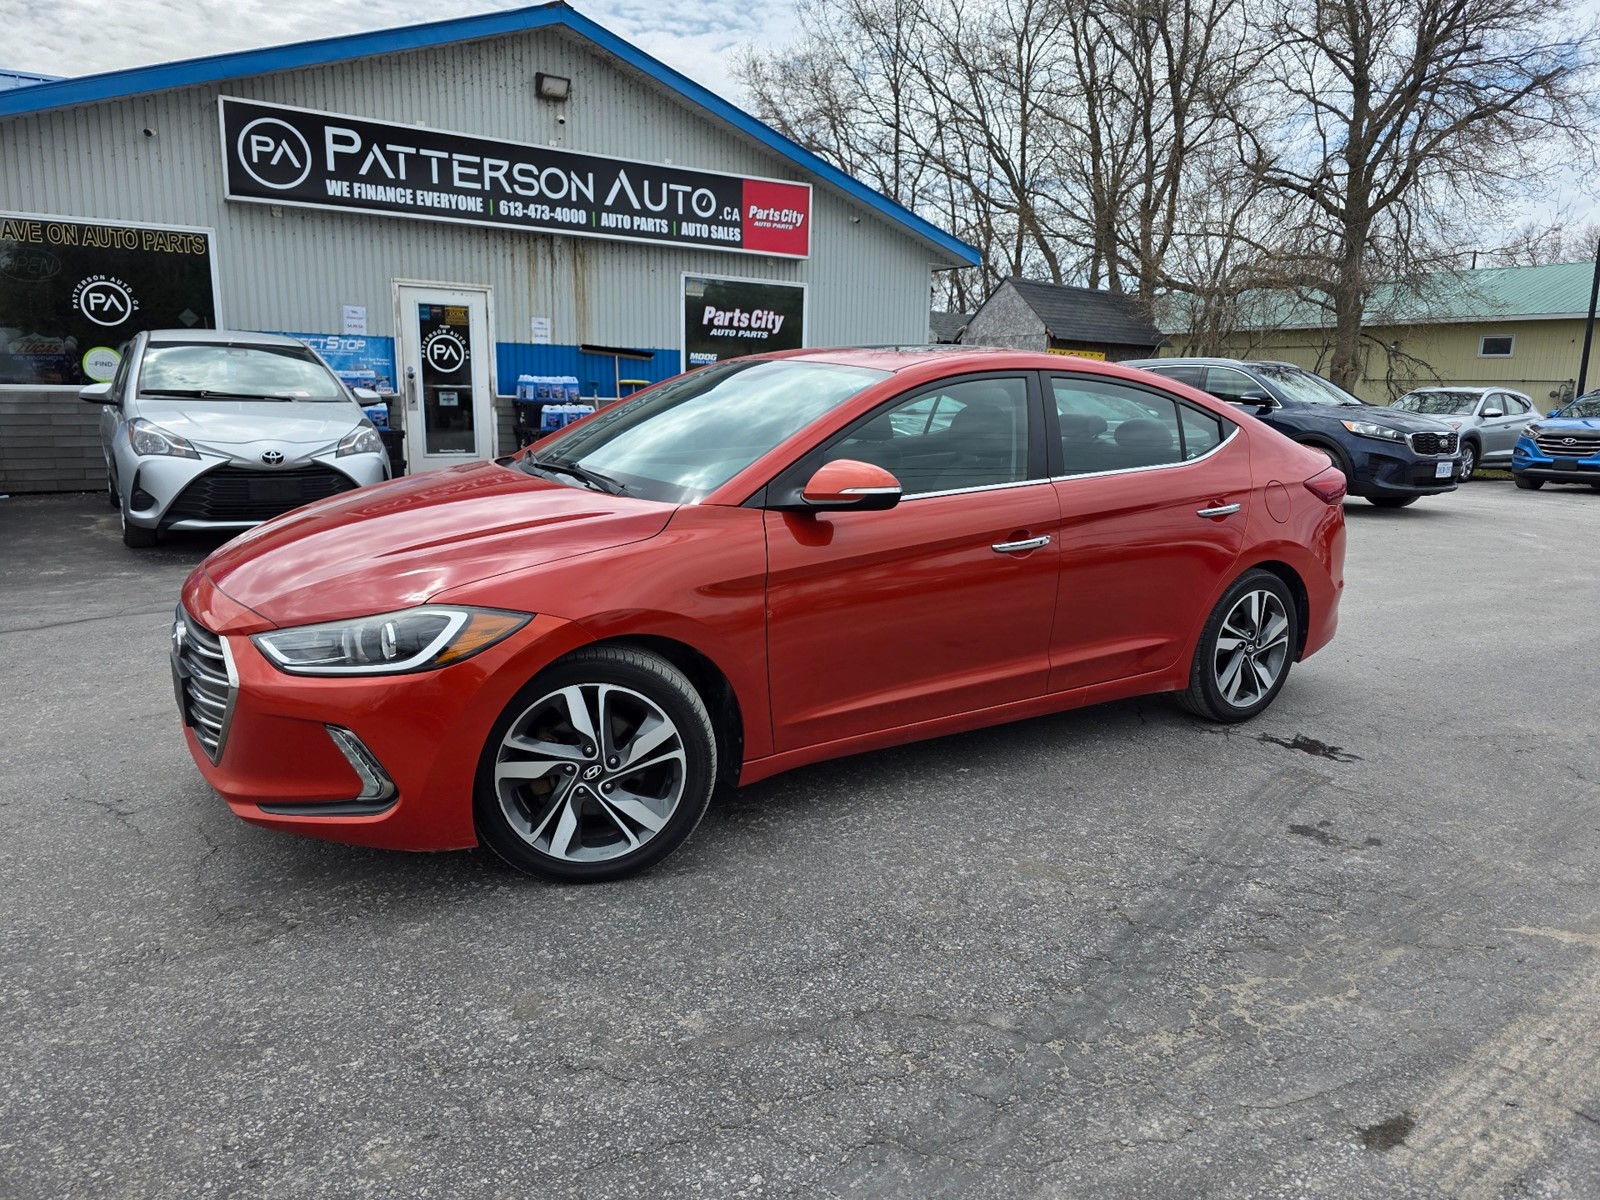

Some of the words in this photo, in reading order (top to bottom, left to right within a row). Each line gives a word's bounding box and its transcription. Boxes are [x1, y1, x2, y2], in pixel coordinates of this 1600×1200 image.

[250, 134, 302, 169] PA
[324, 125, 595, 204] PATTERSON
[325, 178, 351, 197] WE
[352, 182, 414, 205] FINANCE
[415, 189, 484, 213] EVERYONE
[499, 199, 588, 225] 613-473-4000
[600, 212, 632, 230] AUTO
[632, 216, 669, 234] PARTS
[0, 220, 43, 243] AVE
[47, 224, 79, 246] ON
[82, 226, 139, 250] AUTO
[142, 230, 207, 255] PARTS
[680, 221, 710, 237] AUTO
[710, 224, 742, 242] SALES
[72, 274, 106, 310] PATTERSON
[88, 293, 125, 312] PA
[421, 328, 448, 359] PATTERSON
[710, 329, 736, 337] AUTO
[738, 330, 769, 339] PARTS
[433, 344, 460, 361] PA
[690, 353, 717, 361] MOOG
